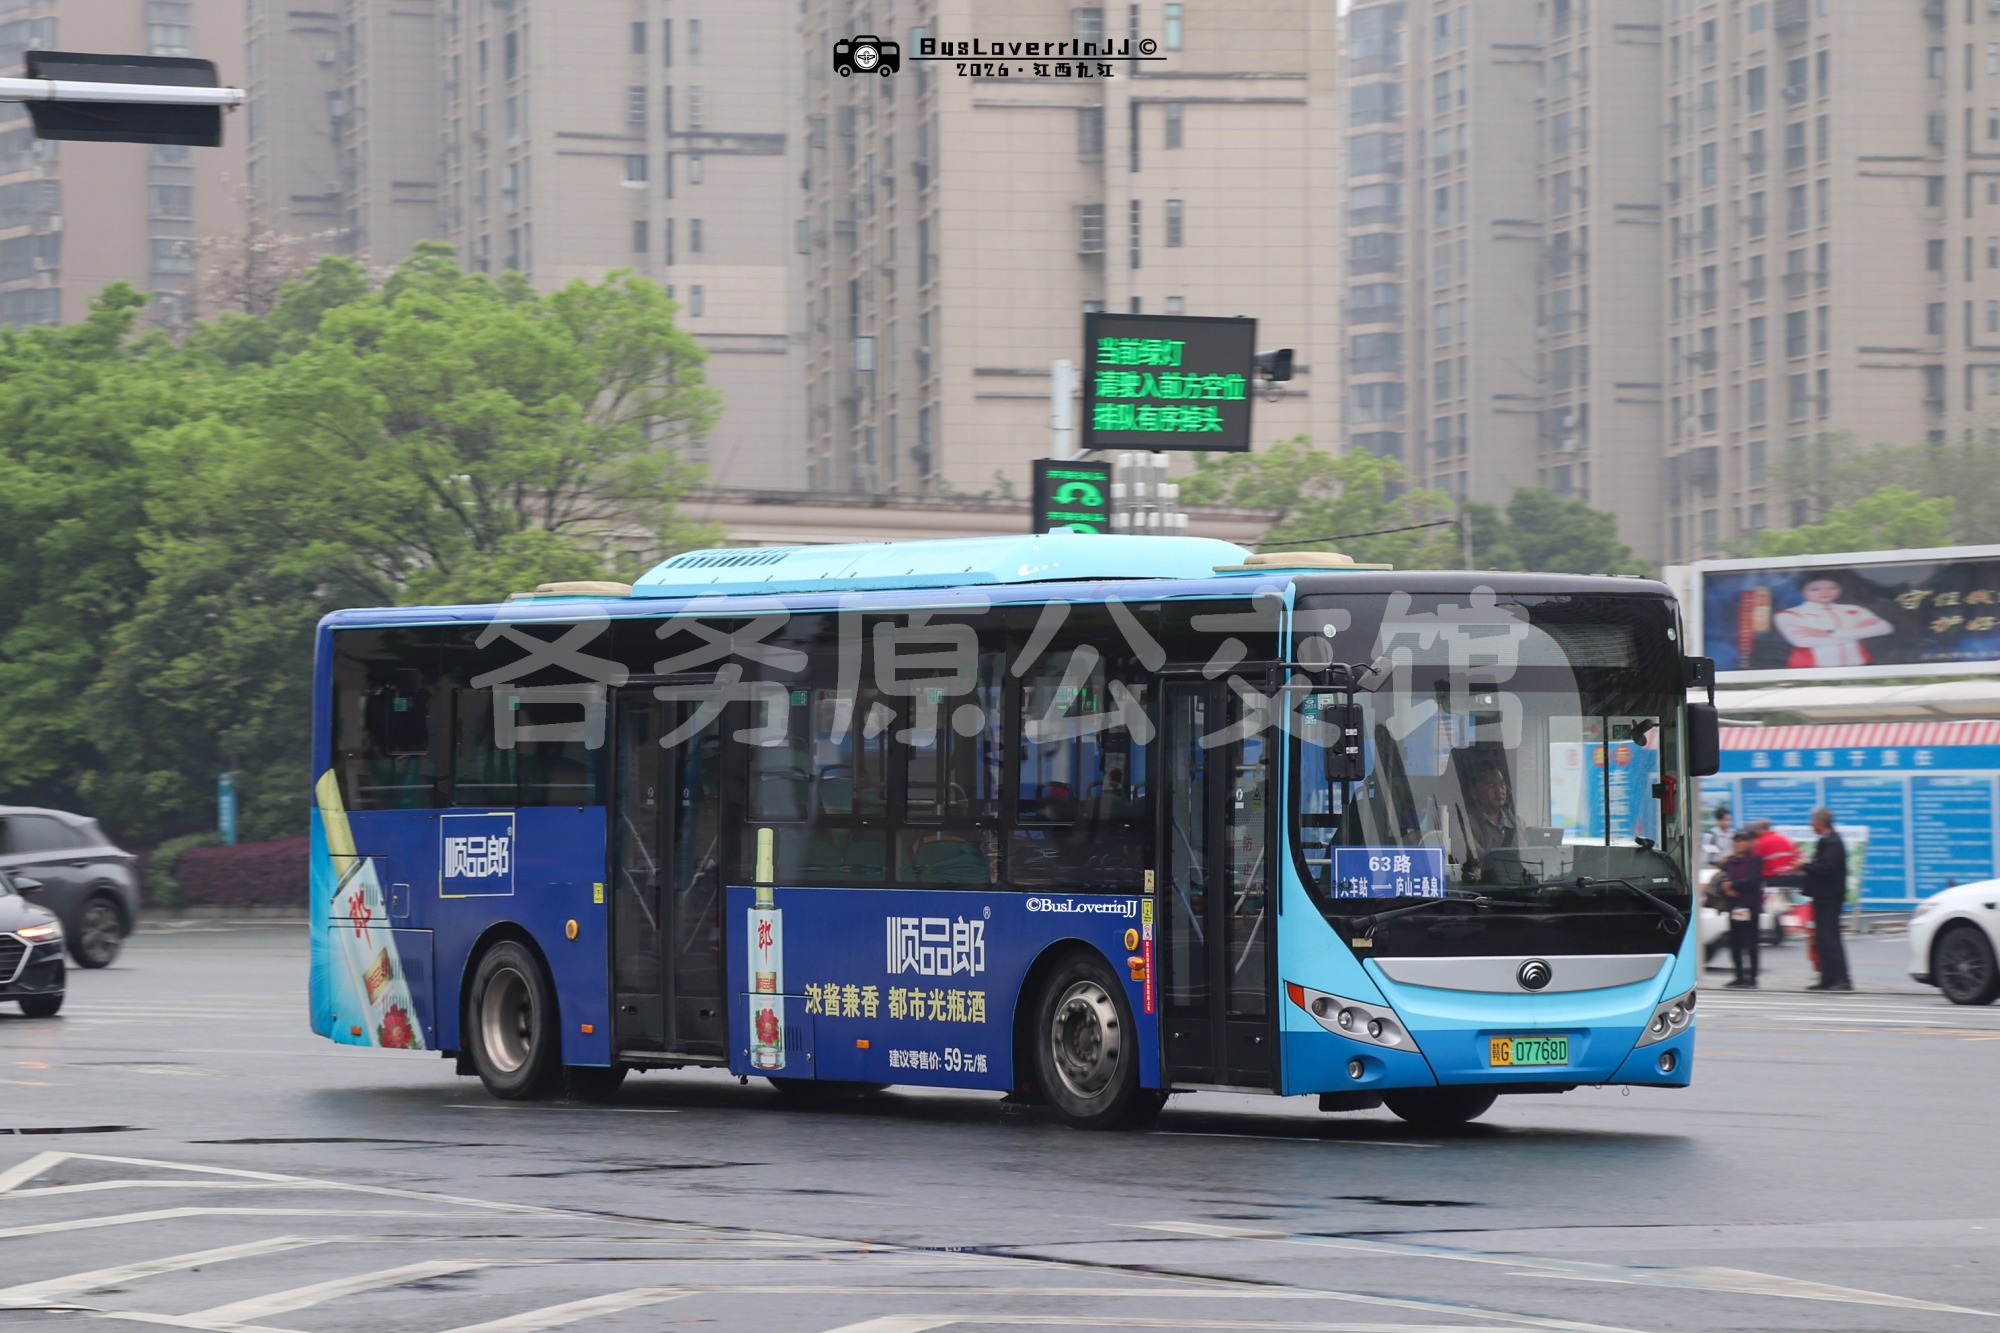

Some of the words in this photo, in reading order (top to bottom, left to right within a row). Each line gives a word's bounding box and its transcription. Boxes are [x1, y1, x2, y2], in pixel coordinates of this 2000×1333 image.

[1096, 337, 1186, 366] 当前绿灯
[445, 835, 509, 877] 顺品郎
[1369, 854, 1412, 874] 63路
[1395, 876, 1439, 898] 庐山三叠泉
[886, 915, 985, 977] 顺品郎
[804, 983, 880, 1018] 浓酱兼香
[888, 986, 986, 1024] 都市光瓶酒
